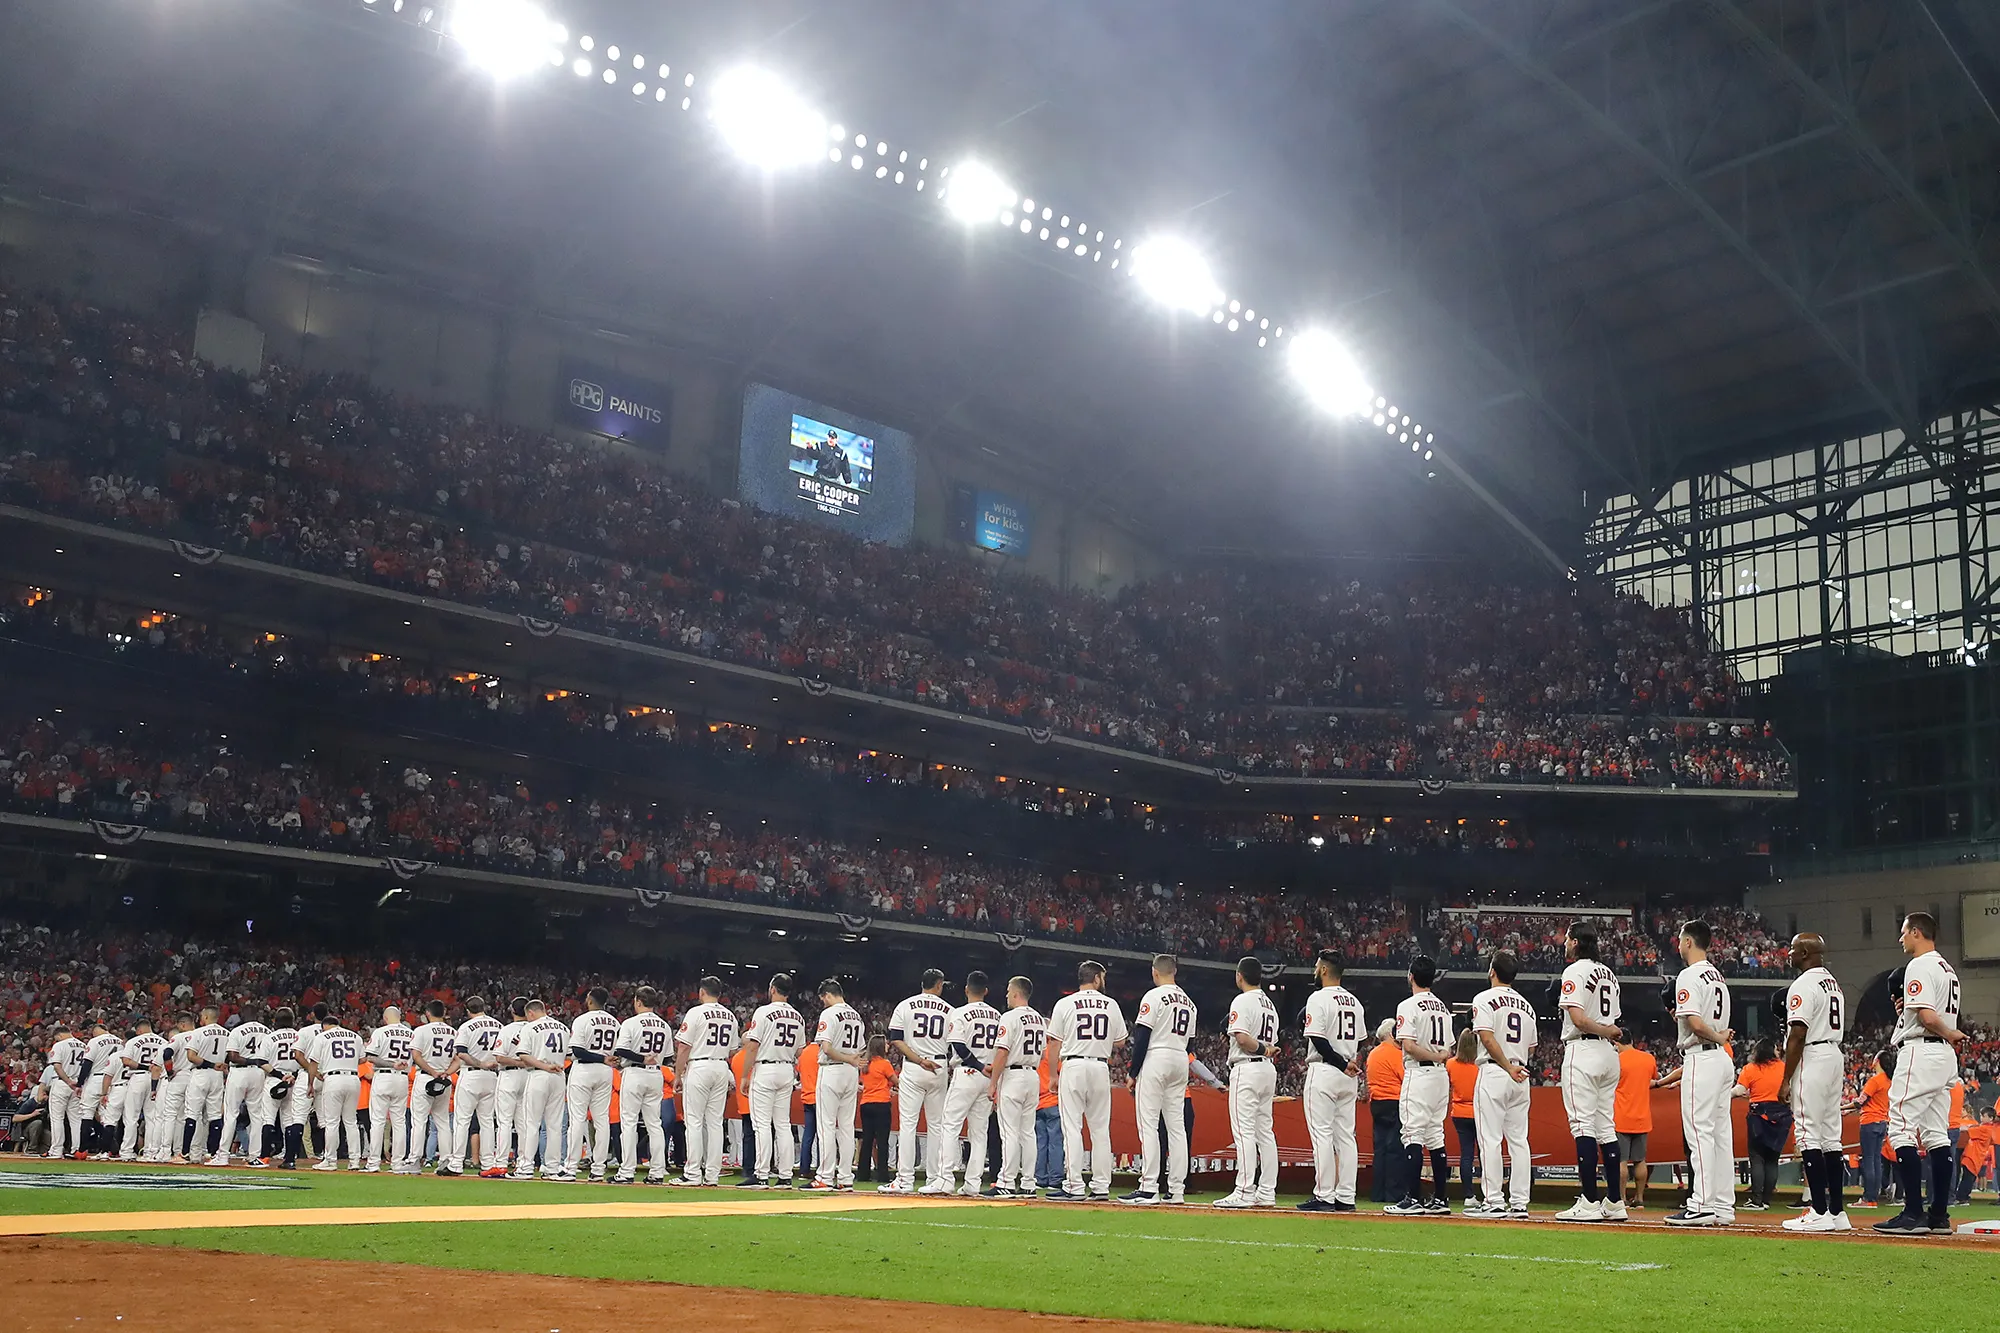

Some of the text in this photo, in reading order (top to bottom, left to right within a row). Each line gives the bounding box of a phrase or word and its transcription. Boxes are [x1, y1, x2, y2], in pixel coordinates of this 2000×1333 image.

[573, 384, 662, 424] PPG PAINTS
[799, 478, 821, 493] ERIC
[823, 485, 860, 505] COOPER
[993, 503, 1017, 517] wins
[984, 511, 1024, 533] for kids
[1074, 1000, 1109, 1010] MILEY
[1333, 995, 1356, 1007] TORO
[1601, 985, 1610, 1017] 6
[1714, 987, 1722, 1020] 3
[1945, 979, 1958, 1014] 15
[590, 1018, 617, 1028] JAMES
[703, 1010, 735, 1022] HARRIS
[1171, 1006, 1190, 1036] 18
[1829, 996, 1840, 1030] 8
[384, 1030, 413, 1038] PRESSL
[432, 1028, 456, 1036] OSUNA
[468, 1020, 502, 1032] DEVENS
[533, 1022, 569, 1033] PEACOCK
[640, 1019, 666, 1029] SMITH
[706, 1023, 732, 1046] 36
[913, 1013, 944, 1039] 30
[1077, 1014, 1108, 1040] 20
[1258, 1012, 1274, 1042] 16
[1337, 1010, 1355, 1040] 13
[1430, 1015, 1444, 1046] 11
[1506, 1013, 1521, 1043] 9
[98, 1039, 121, 1047] SPRING
[271, 1033, 297, 1042] REDDI
[477, 1031, 499, 1050] 47
[545, 1033, 563, 1053] 41
[590, 1030, 616, 1050] 39
[640, 1031, 665, 1053] 38
[774, 1023, 798, 1047] 35
[842, 1024, 859, 1048] 31
[971, 1023, 999, 1049] 28
[1023, 1030, 1043, 1055] 26
[212, 1038, 218, 1055] 1
[332, 1041, 355, 1058] 65
[388, 1040, 411, 1059] 55
[432, 1038, 454, 1057] 54
[70, 1050, 85, 1066] 14
